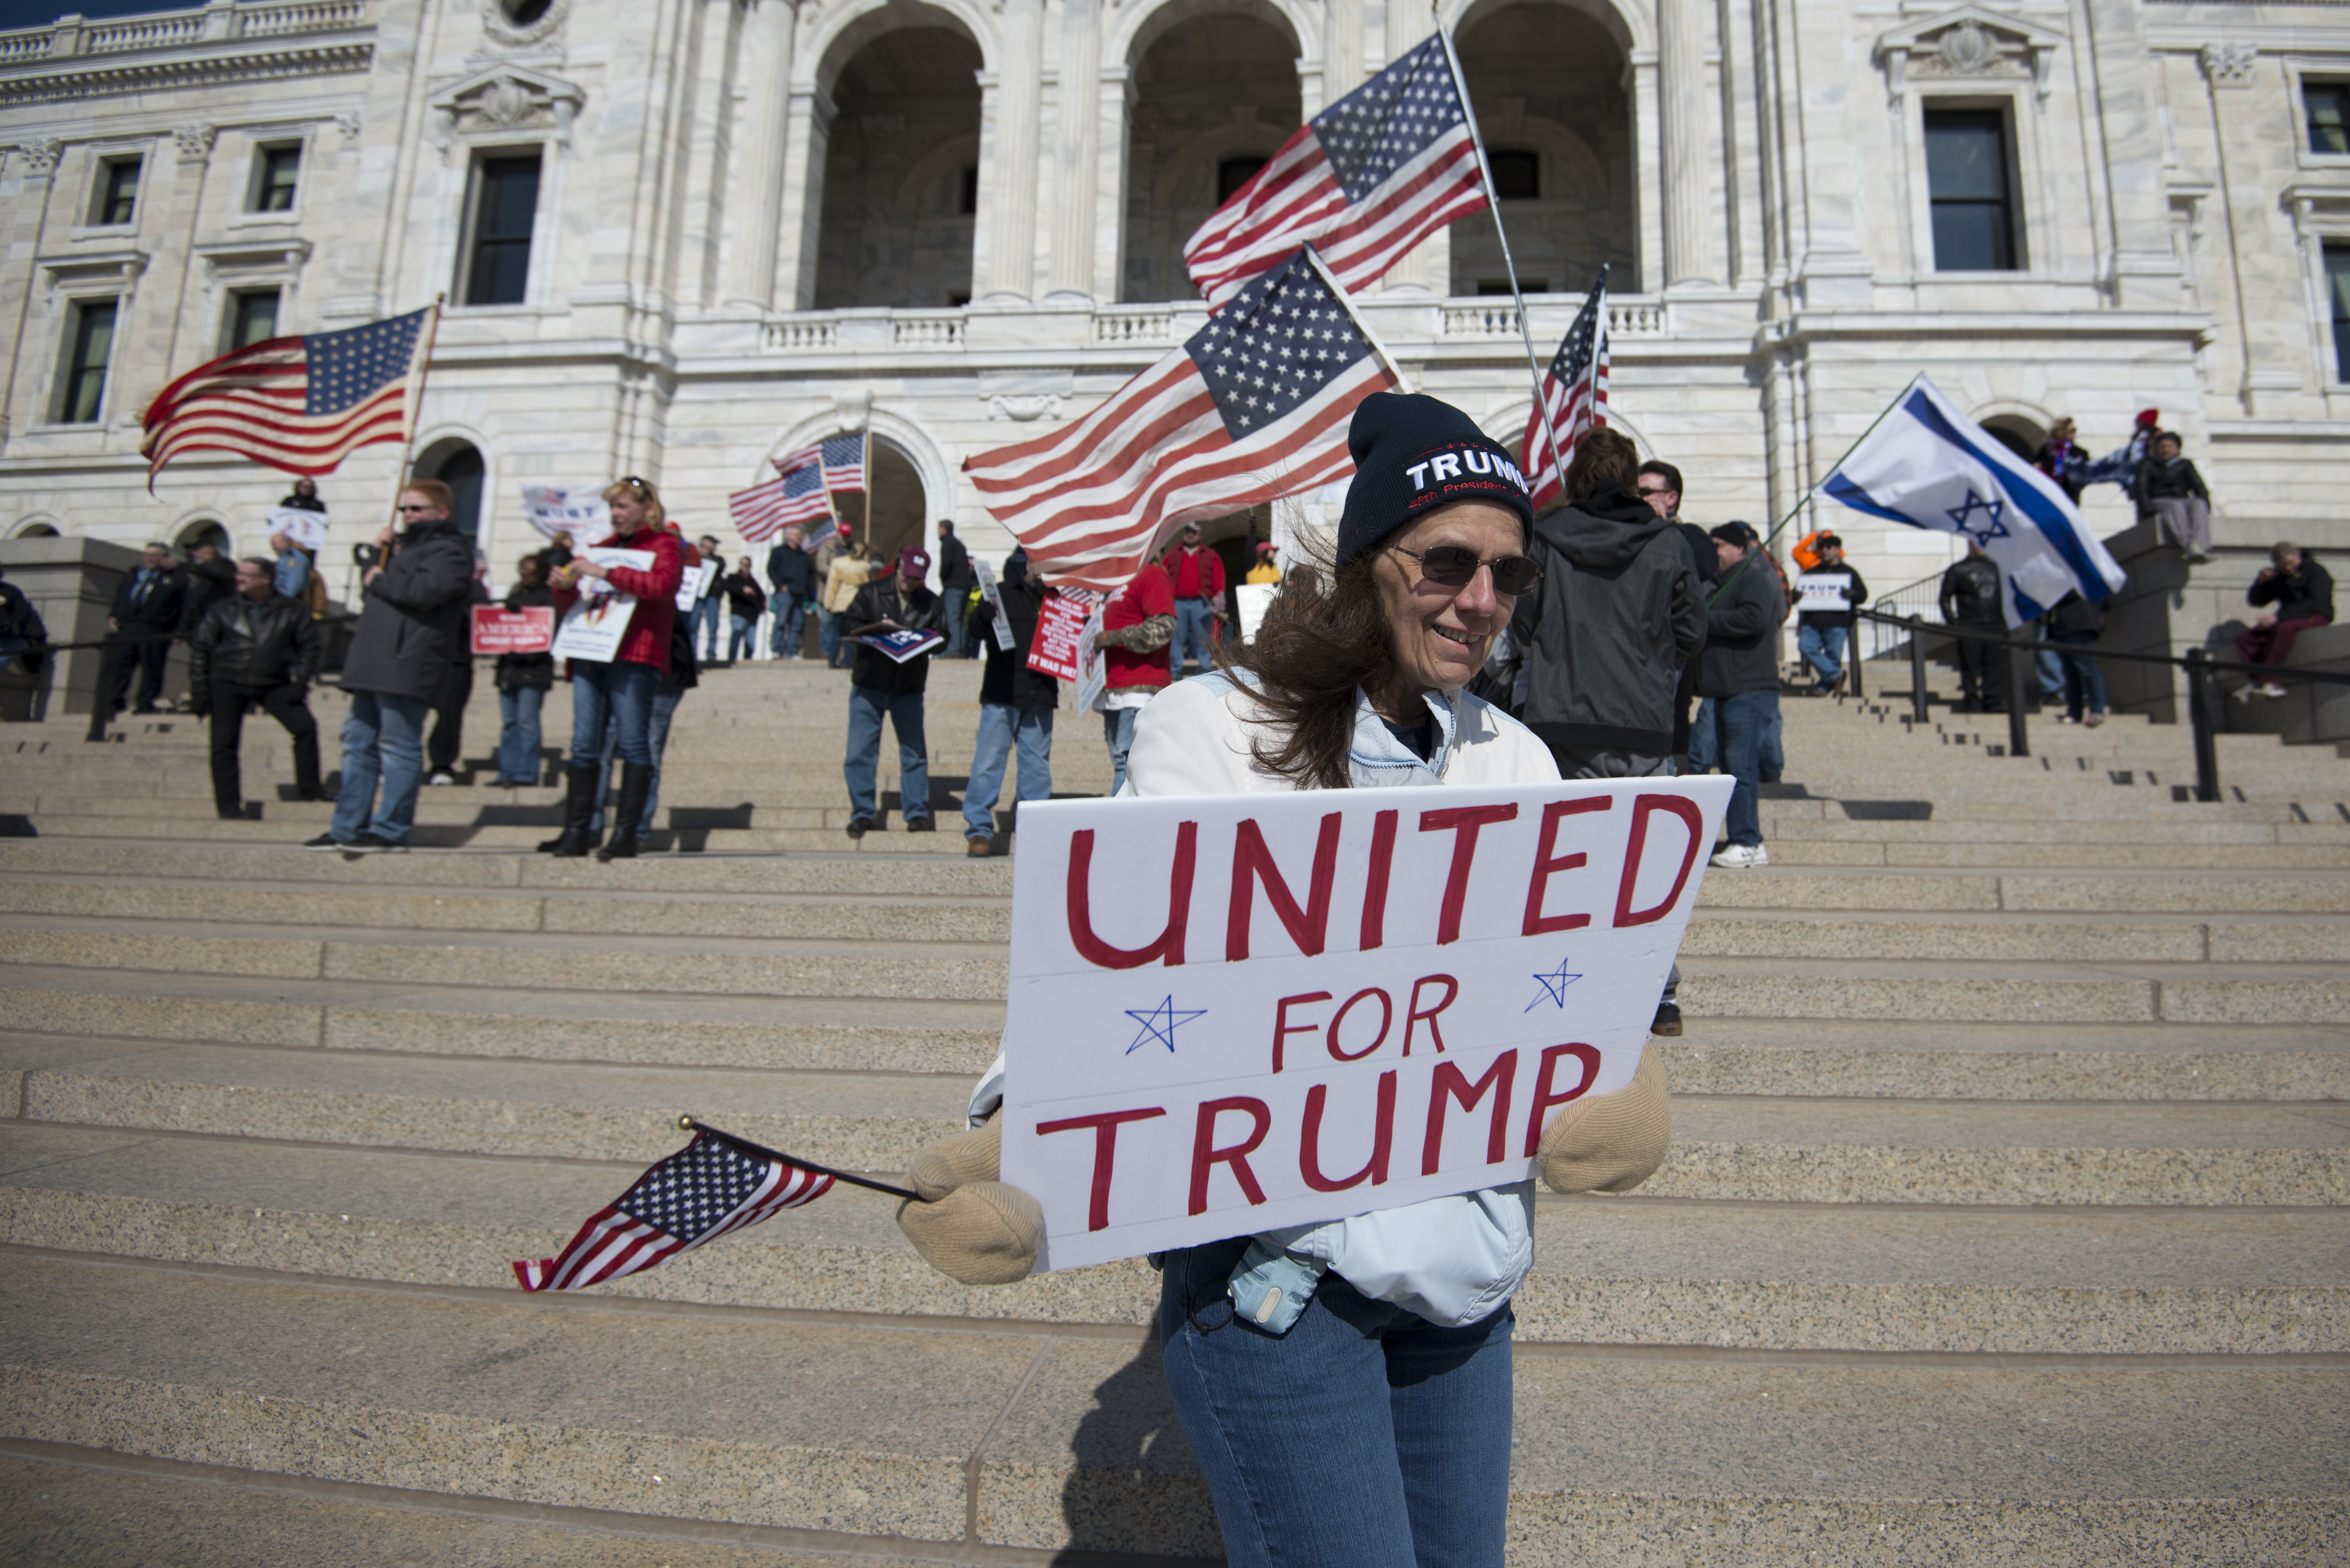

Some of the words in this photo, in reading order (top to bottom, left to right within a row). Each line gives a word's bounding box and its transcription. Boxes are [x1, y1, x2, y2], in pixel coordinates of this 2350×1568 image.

[1409, 491, 1438, 508] 45th
[1444, 480, 1507, 495] President
[1060, 599, 1072, 607] WAS
[478, 622, 550, 635] AMERICA
[1044, 611, 1065, 623] DONALD
[1066, 619, 1084, 630] TRUMP
[1052, 621, 1073, 632] GETTING
[479, 636, 512, 645] GREAT
[514, 636, 545, 645] AGAIN
[1041, 628, 1052, 636] THE
[1052, 633, 1077, 646] RUSSIANS
[1059, 641, 1070, 649] THE
[1042, 641, 1071, 657] ELECTORAL
[1028, 653, 1039, 665] IT
[1039, 657, 1059, 673] WAS
[1060, 665, 1077, 678] ME!
[1067, 794, 1703, 969] UNITED
[1273, 974, 1459, 1074] FOR
[1036, 1042, 1602, 1232] TRUMP
